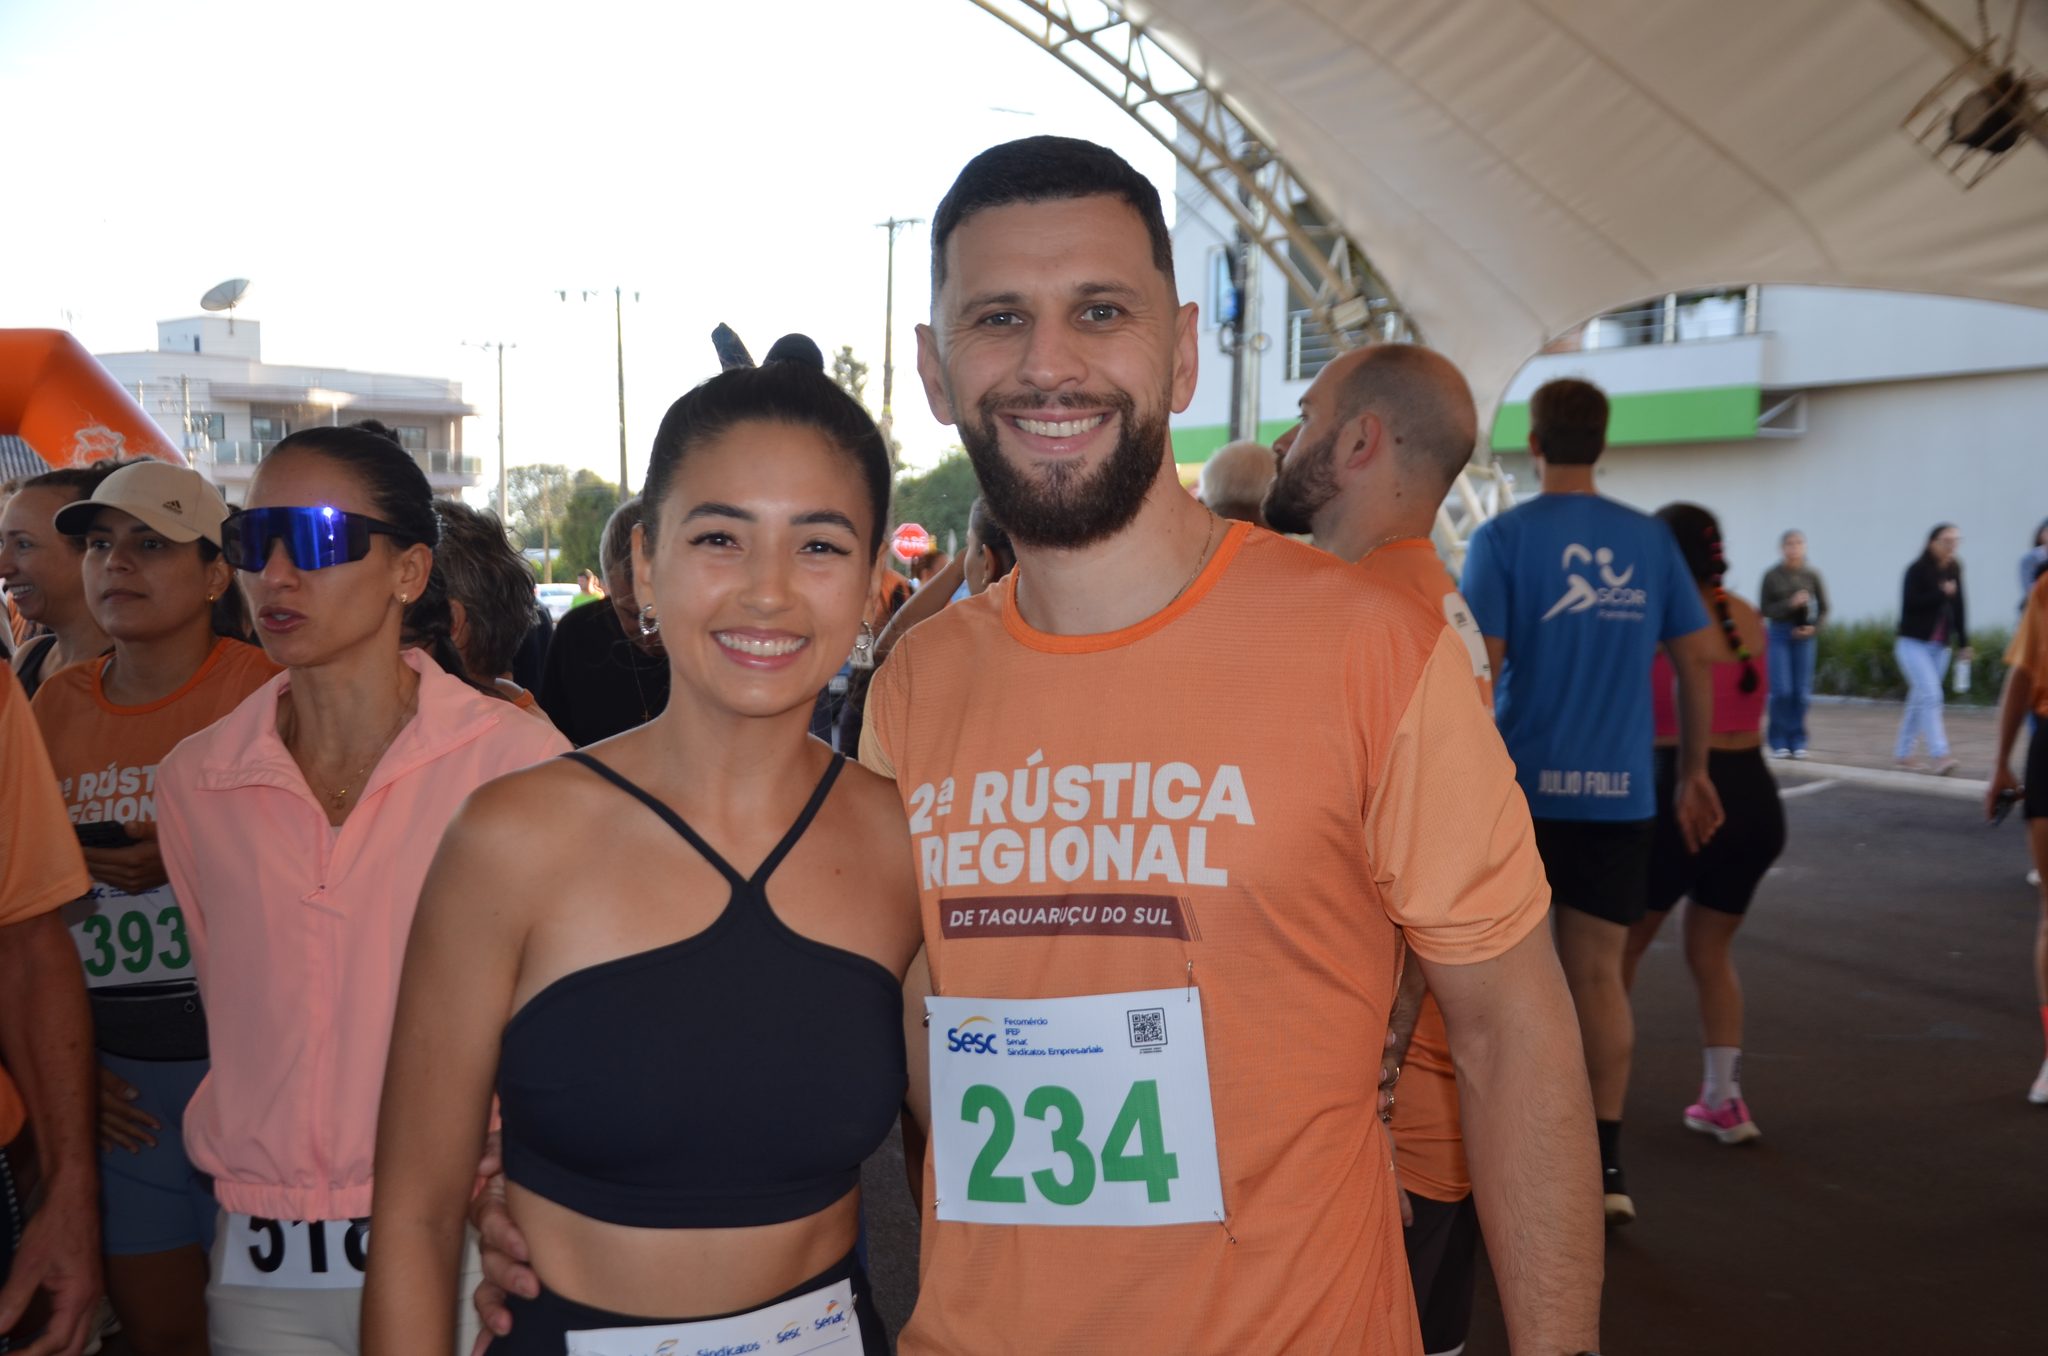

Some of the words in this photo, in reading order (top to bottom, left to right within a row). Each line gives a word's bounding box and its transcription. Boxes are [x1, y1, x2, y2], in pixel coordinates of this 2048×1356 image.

[77, 761, 160, 802] RÚST
[969, 748, 1255, 825] RÚSTICA
[67, 794, 159, 824] EGION
[921, 824, 1227, 890] REGIONAL
[950, 910, 975, 927] DE
[979, 906, 1097, 926] TAQUARUÇU
[1101, 907, 1126, 923] DO
[1133, 907, 1172, 925] SUL
[82, 906, 191, 977] 393
[1004, 1017, 1048, 1026] Fecomércio
[948, 1027, 998, 1054] Sesc
[1006, 1038, 1028, 1046] Senac
[1008, 1047, 1046, 1056] Sindicatos
[1048, 1045, 1104, 1056] Empresariais
[961, 1079, 1179, 1206] 234
[815, 1310, 845, 1331] Senac
